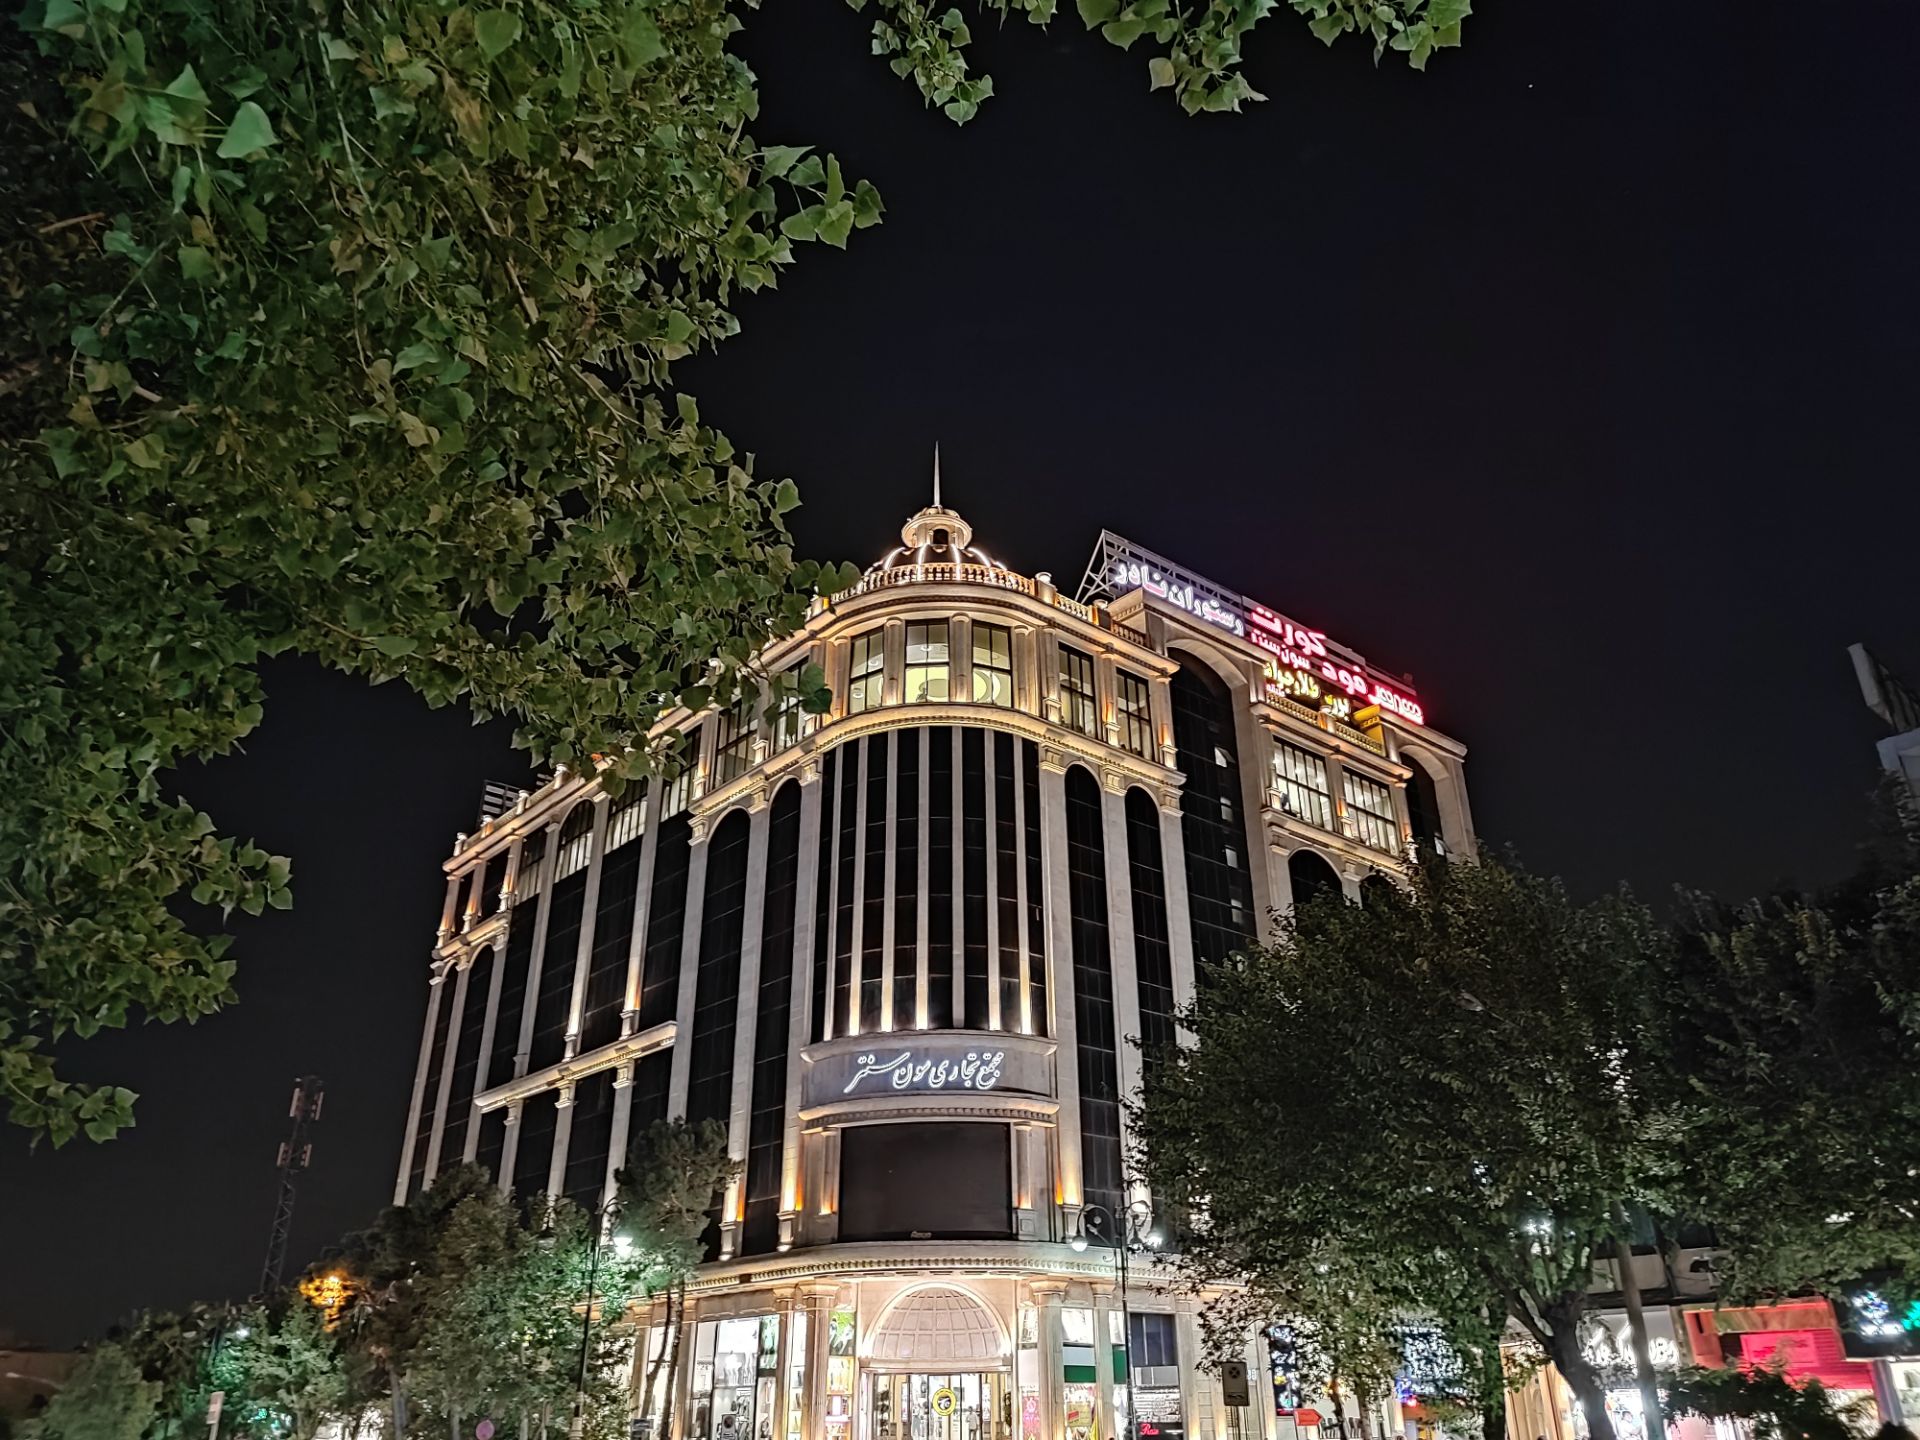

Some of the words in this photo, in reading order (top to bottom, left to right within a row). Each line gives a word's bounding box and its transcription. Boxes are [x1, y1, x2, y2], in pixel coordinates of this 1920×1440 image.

[1168, 585, 1245, 637] رستوران
[1251, 607, 1327, 657] کورت
[1280, 644, 1311, 670] سون
[1321, 661, 1369, 695] فود
[843, 1051, 910, 1093] سنتر
[892, 1059, 932, 1089] سون
[929, 1052, 981, 1088] تجاری
[976, 1052, 1005, 1090] مجتمع
